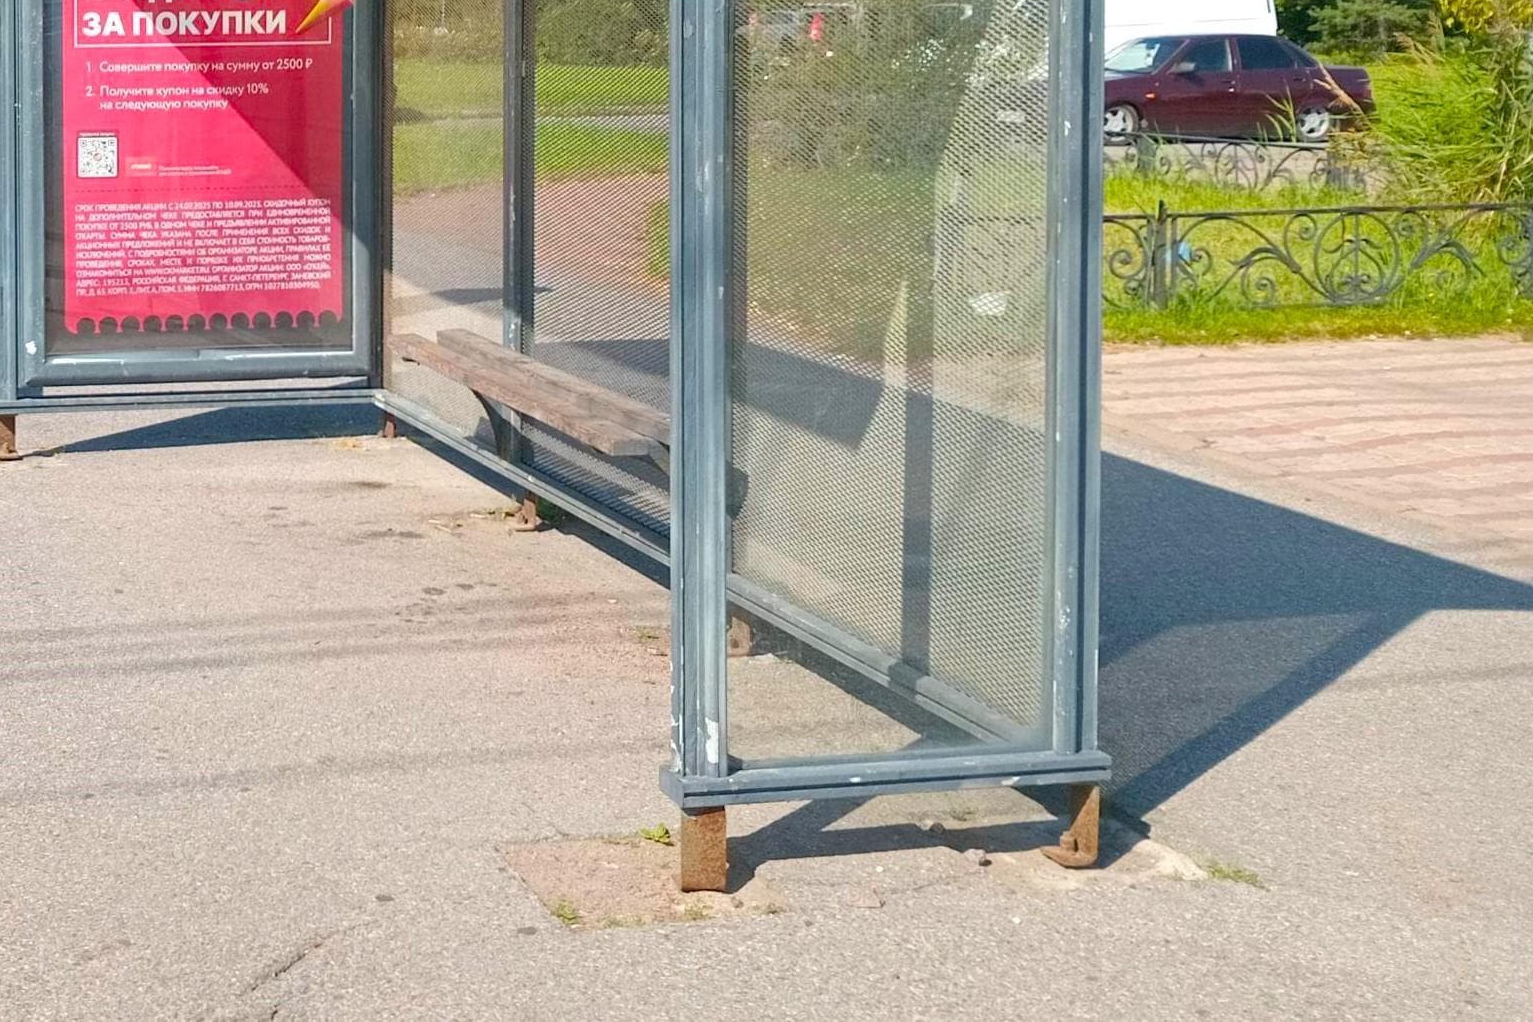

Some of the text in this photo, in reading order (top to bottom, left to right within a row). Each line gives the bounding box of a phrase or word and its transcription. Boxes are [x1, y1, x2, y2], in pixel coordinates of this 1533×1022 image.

[81, 9, 287, 37] ЗА ПОКУПКИ
[85, 61, 92, 74] 1
[99, 60, 162, 74] Совершите
[164, 62, 210, 74] покупку
[211, 62, 225, 71] на
[226, 61, 260, 73] сумму
[261, 61, 275, 70] от
[276, 57, 304, 70] 2500
[85, 82, 270, 98] 2 Получите купон на скидку 10%
[99, 98, 229, 113] на следующую покупку
